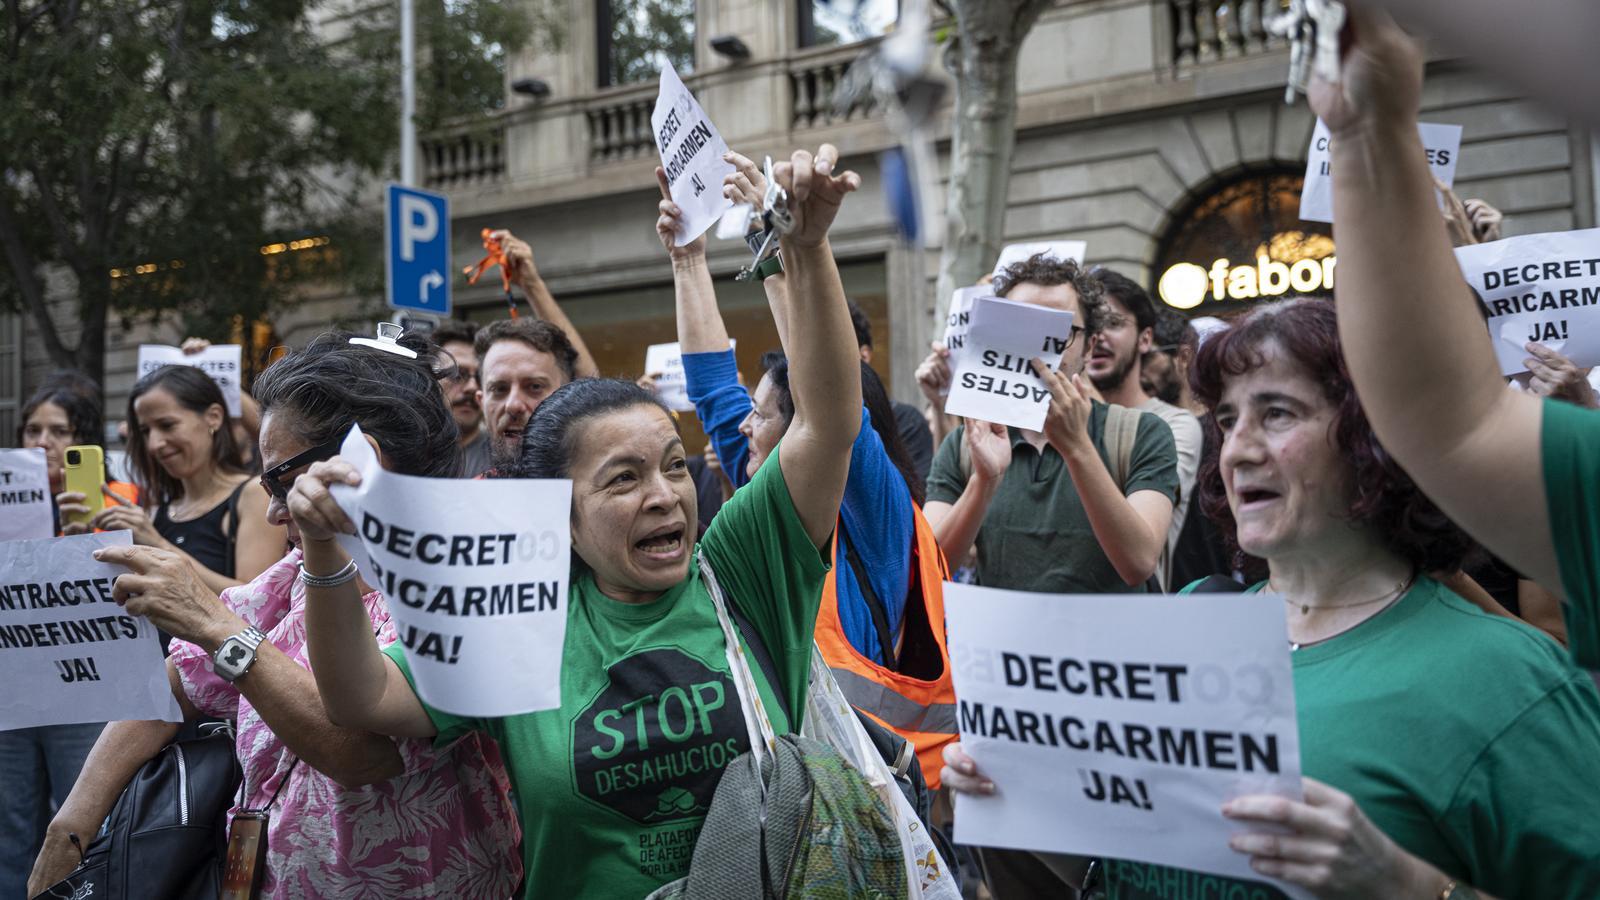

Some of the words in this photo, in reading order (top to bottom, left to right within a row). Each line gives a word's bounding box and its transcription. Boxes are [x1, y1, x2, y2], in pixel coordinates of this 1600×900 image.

[401, 196, 439, 262] P
[1483, 259, 1600, 291] DECRET
[1528, 320, 1568, 342] JA!
[362, 511, 516, 566] DECRET
[0, 576, 118, 611] NTRACTE
[0, 615, 138, 649] NDEFINITS
[399, 625, 463, 664] JA!
[60, 657, 101, 683] JA!
[1002, 652, 1188, 703] DECRET
[591, 680, 726, 760] STOP
[960, 699, 1280, 774] MARICARMEN
[594, 737, 740, 795] DESAHUCIOS
[1083, 769, 1153, 811] JA!
